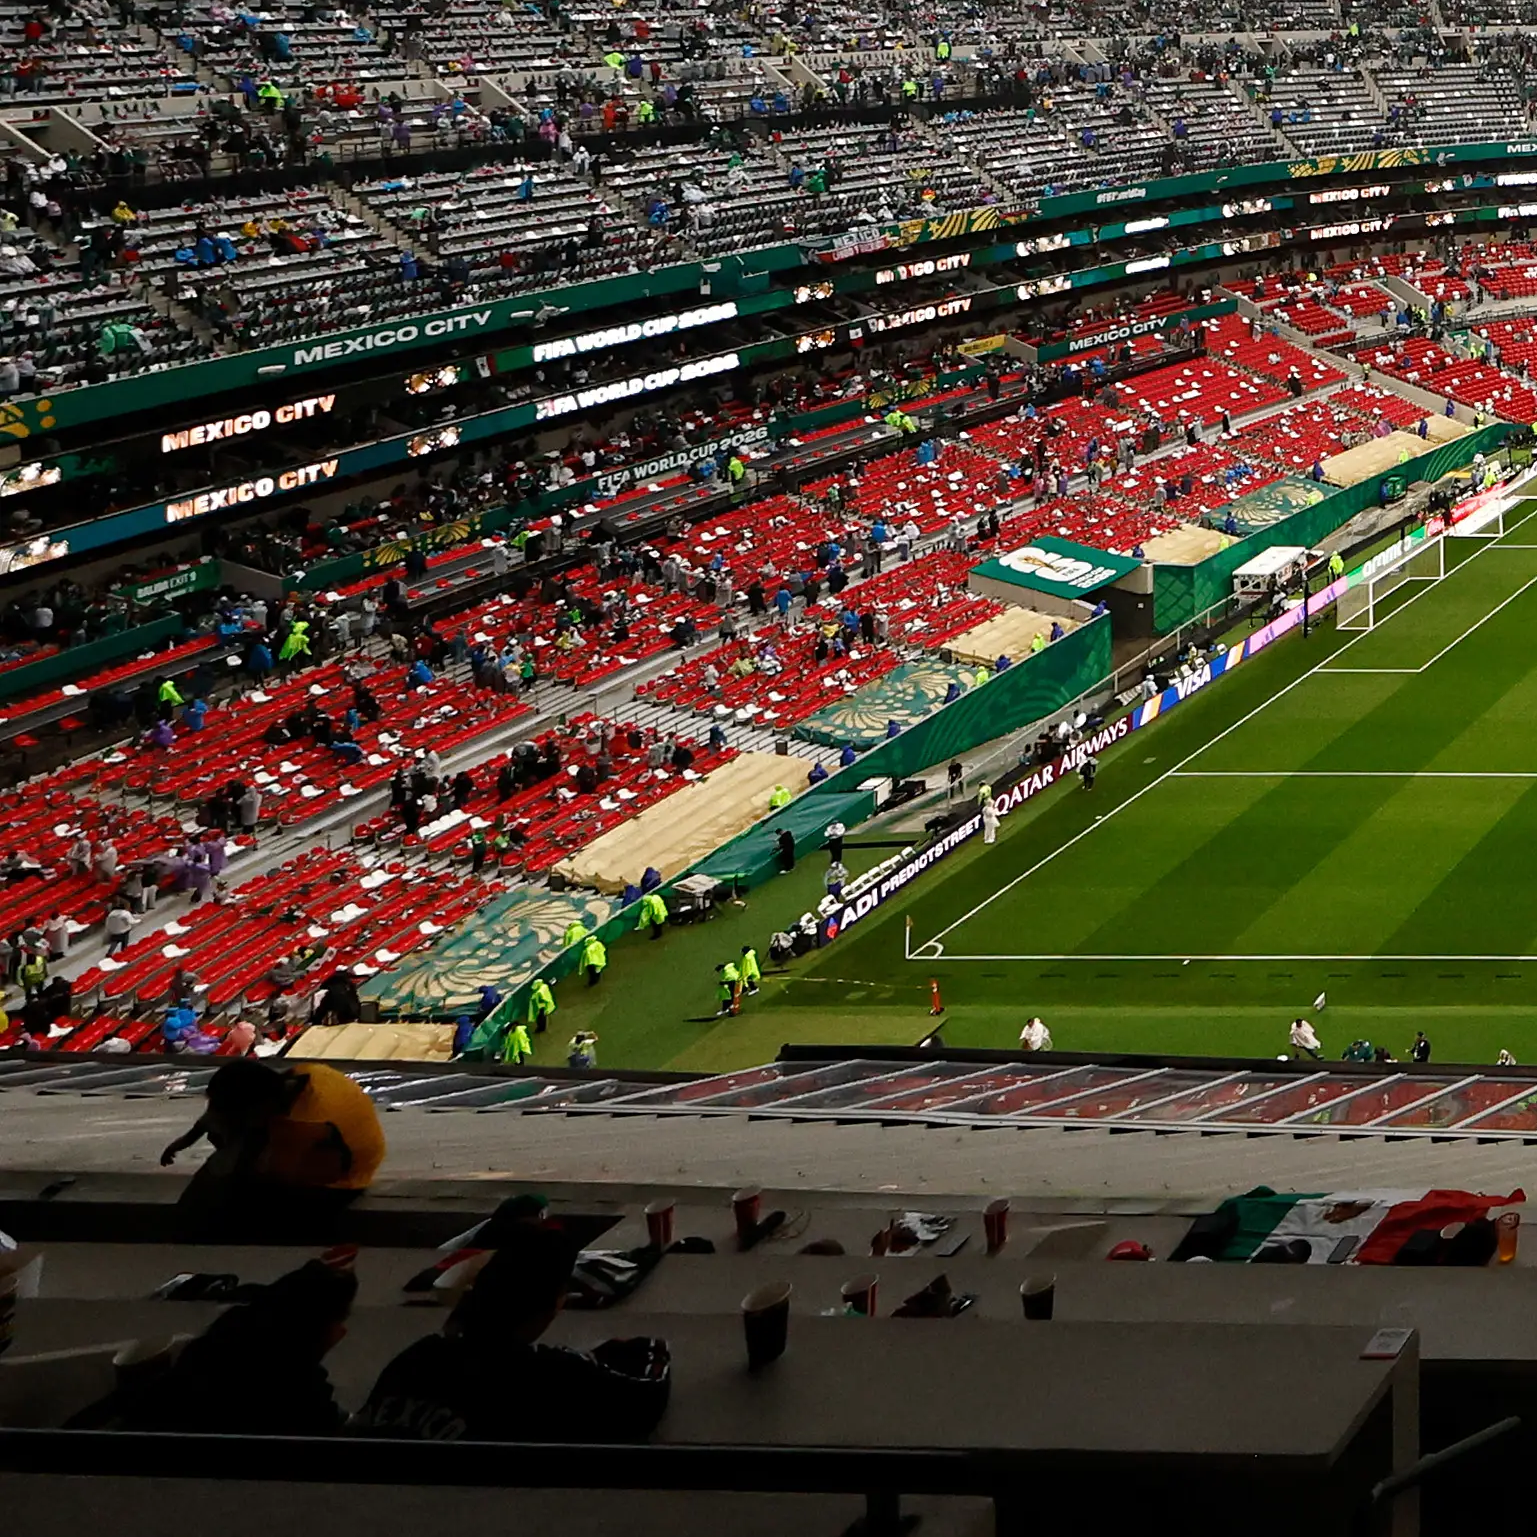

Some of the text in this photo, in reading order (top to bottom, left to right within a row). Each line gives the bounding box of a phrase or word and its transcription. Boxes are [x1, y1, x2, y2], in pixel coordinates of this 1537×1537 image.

[1360, 185, 1390, 198] CITY
[936, 253, 971, 271] CITY
[642, 315, 678, 337] CUP
[937, 299, 972, 317] CITY
[293, 310, 492, 365] MEXICO CITY
[1069, 316, 1168, 352] MEXICO CITY
[643, 367, 680, 390] CUP
[161, 394, 336, 453] MEXICO CITY
[597, 426, 768, 491] FIFA WORLD CUP 2026
[166, 459, 339, 523] MEXICO CITY
[1173, 663, 1211, 700] VISA
[994, 716, 1128, 816] QATAR AIRWAYS
[840, 887, 879, 930] ADI
